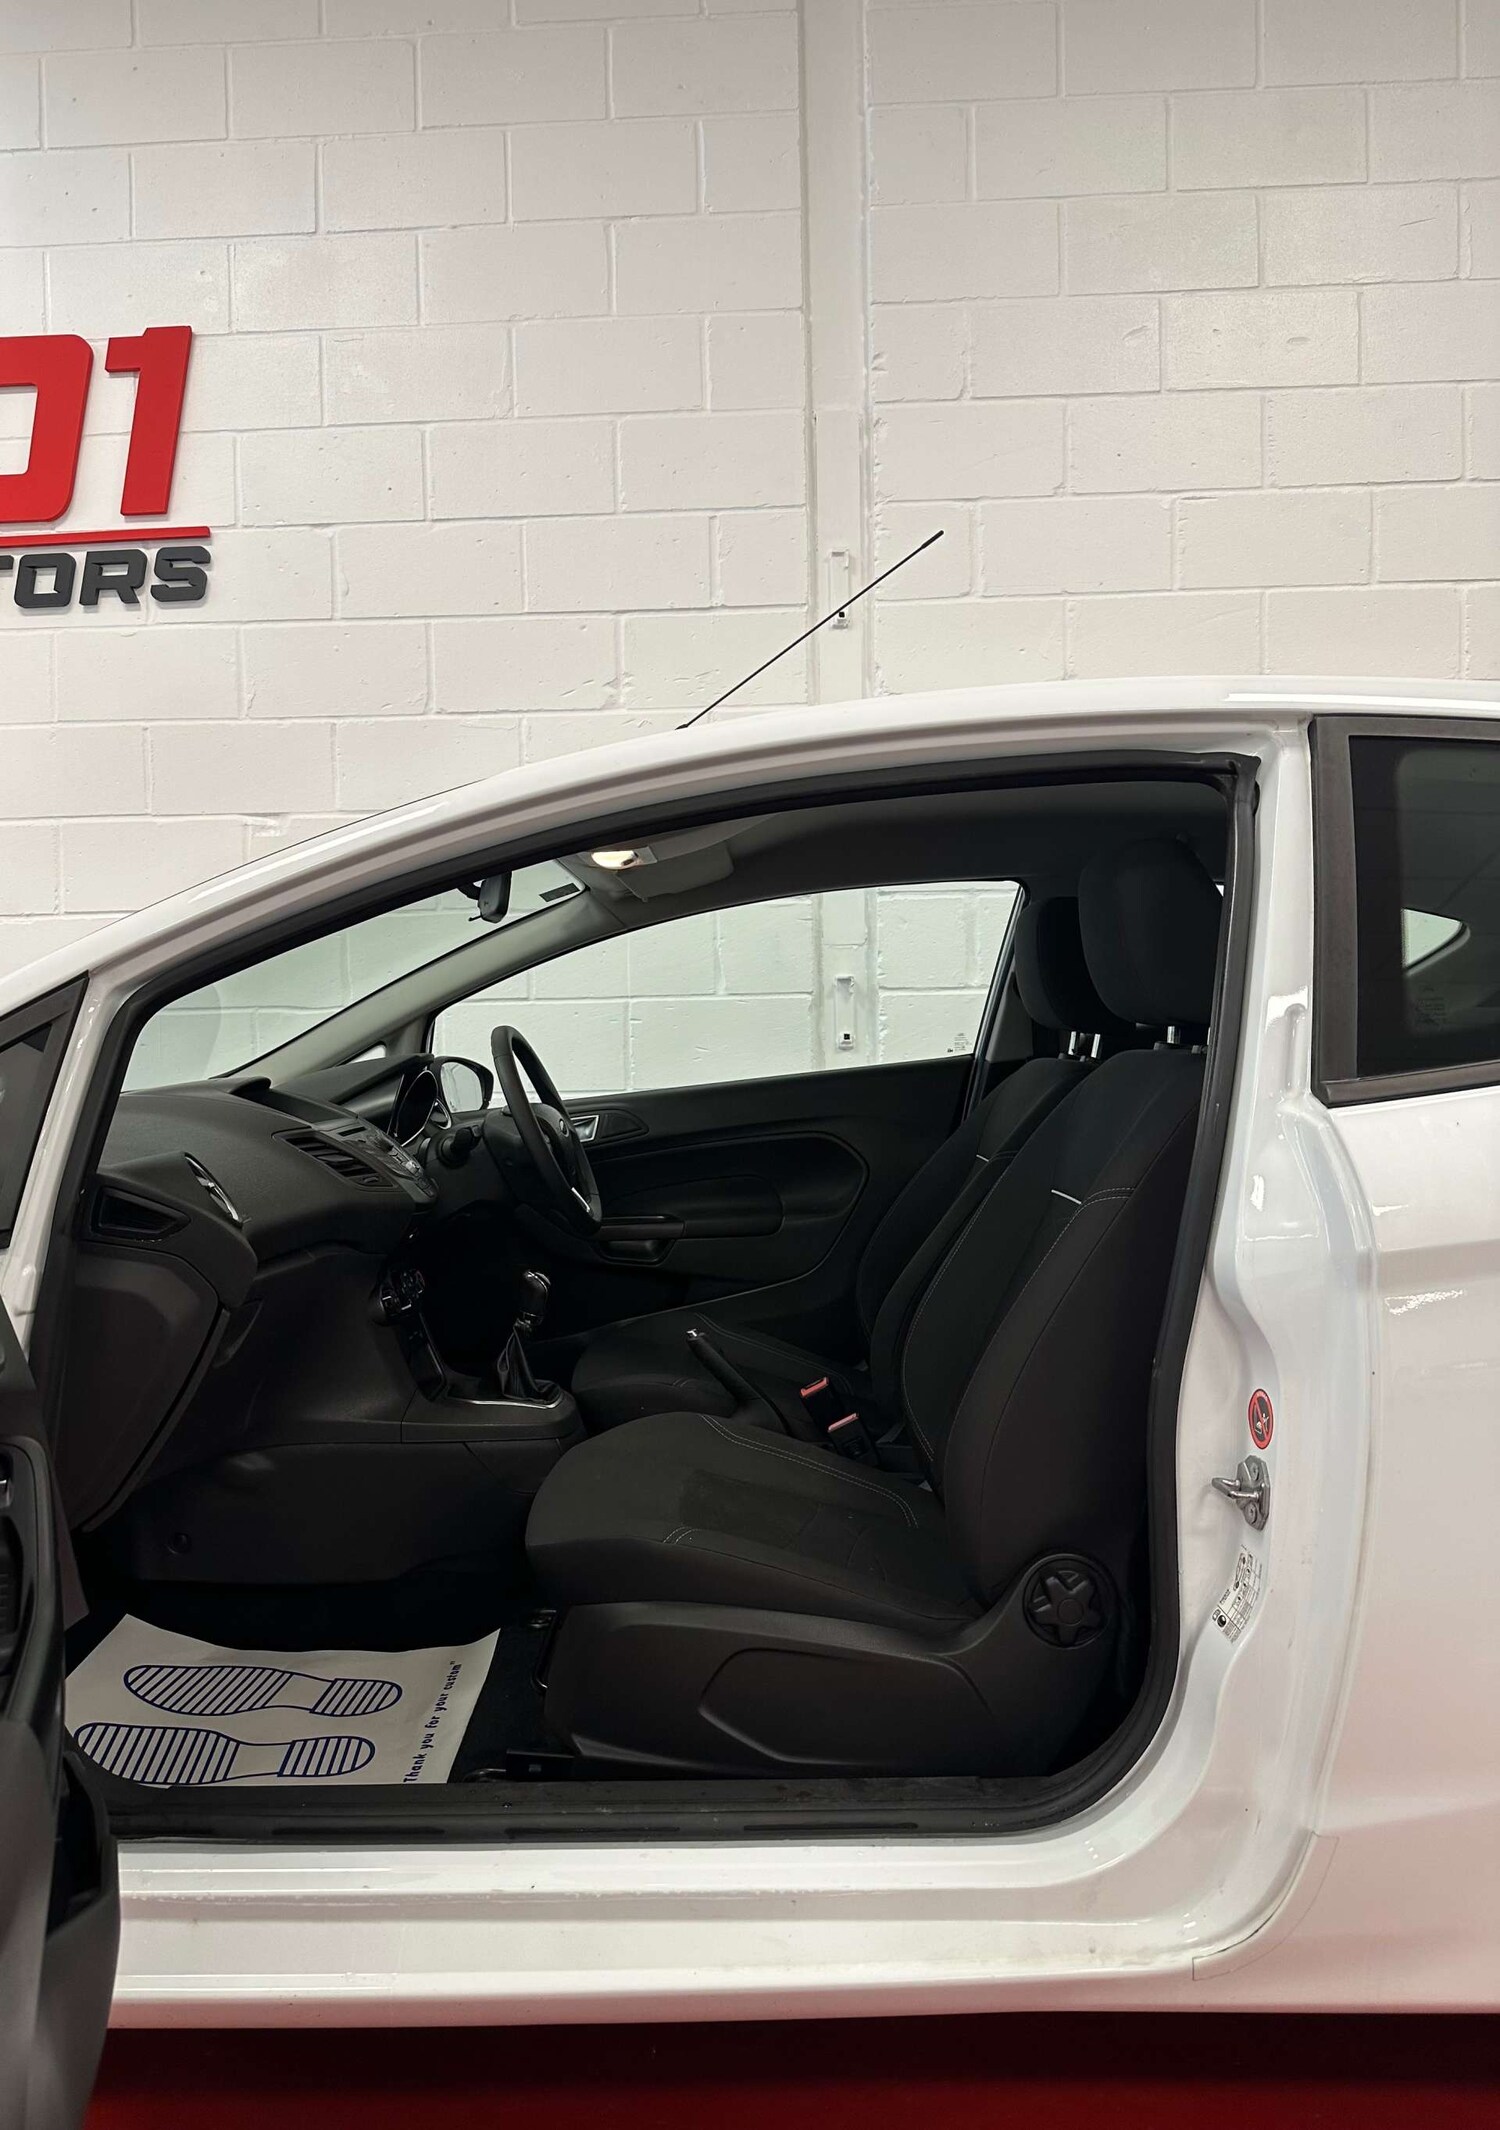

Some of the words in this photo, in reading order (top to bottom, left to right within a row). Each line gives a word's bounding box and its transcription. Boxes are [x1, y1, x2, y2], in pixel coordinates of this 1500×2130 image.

[0, 546, 211, 608] ORS
[434, 1693, 449, 1712] your
[425, 1716, 440, 1728] for
[420, 1733, 435, 1749] you
[403, 1753, 427, 1783] Thank
